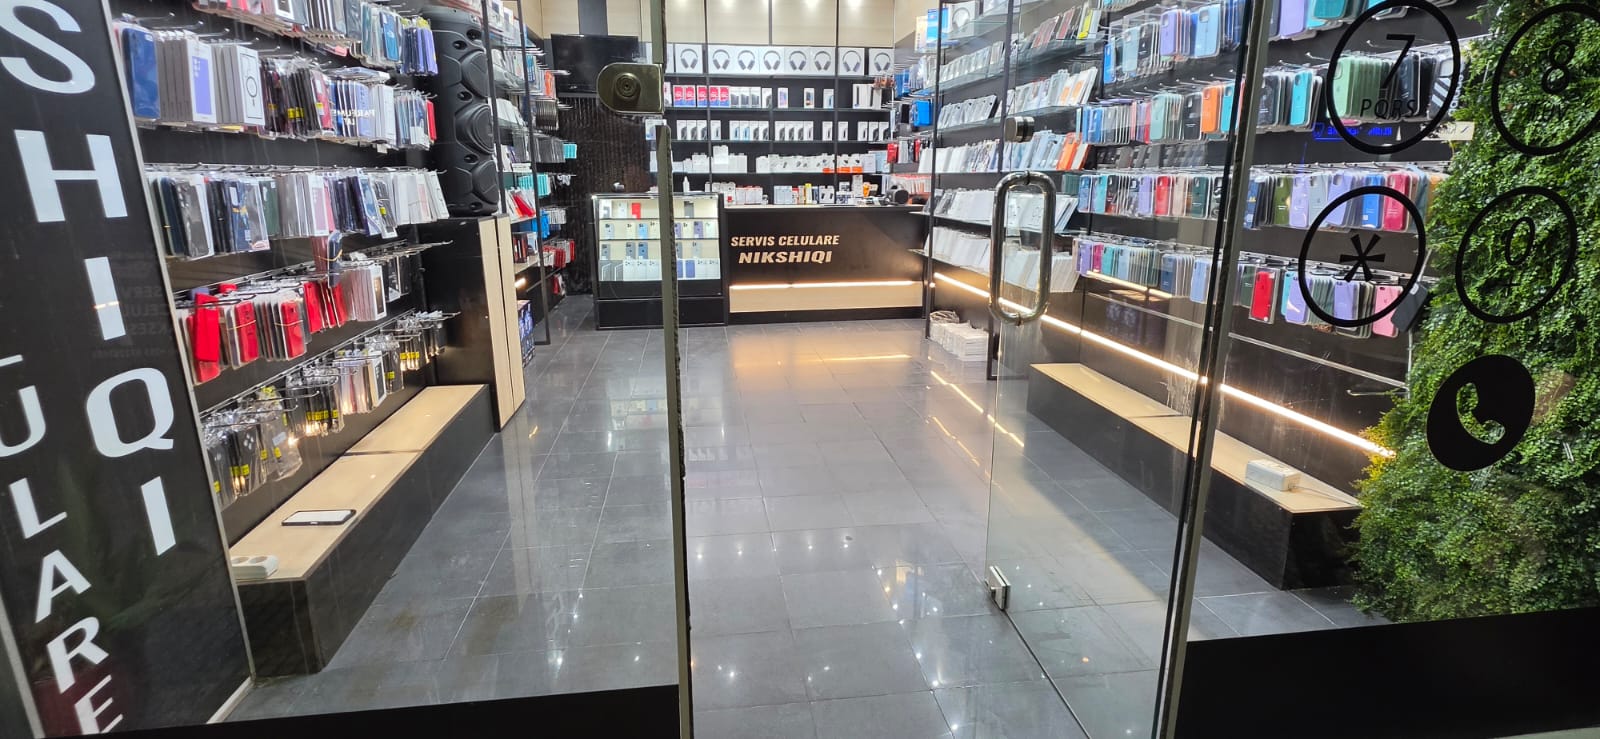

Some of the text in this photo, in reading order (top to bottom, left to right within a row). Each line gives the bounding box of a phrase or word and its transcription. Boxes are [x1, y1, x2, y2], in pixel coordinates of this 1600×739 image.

[1381, 33, 1416, 89] 7
[1541, 40, 1575, 94] 8
[1360, 98, 1416, 119] PQRS
[730, 235, 840, 247] SERVIS CELULARE
[738, 251, 832, 264] NIKSHIQI
[1505, 217, 1536, 265] 0
